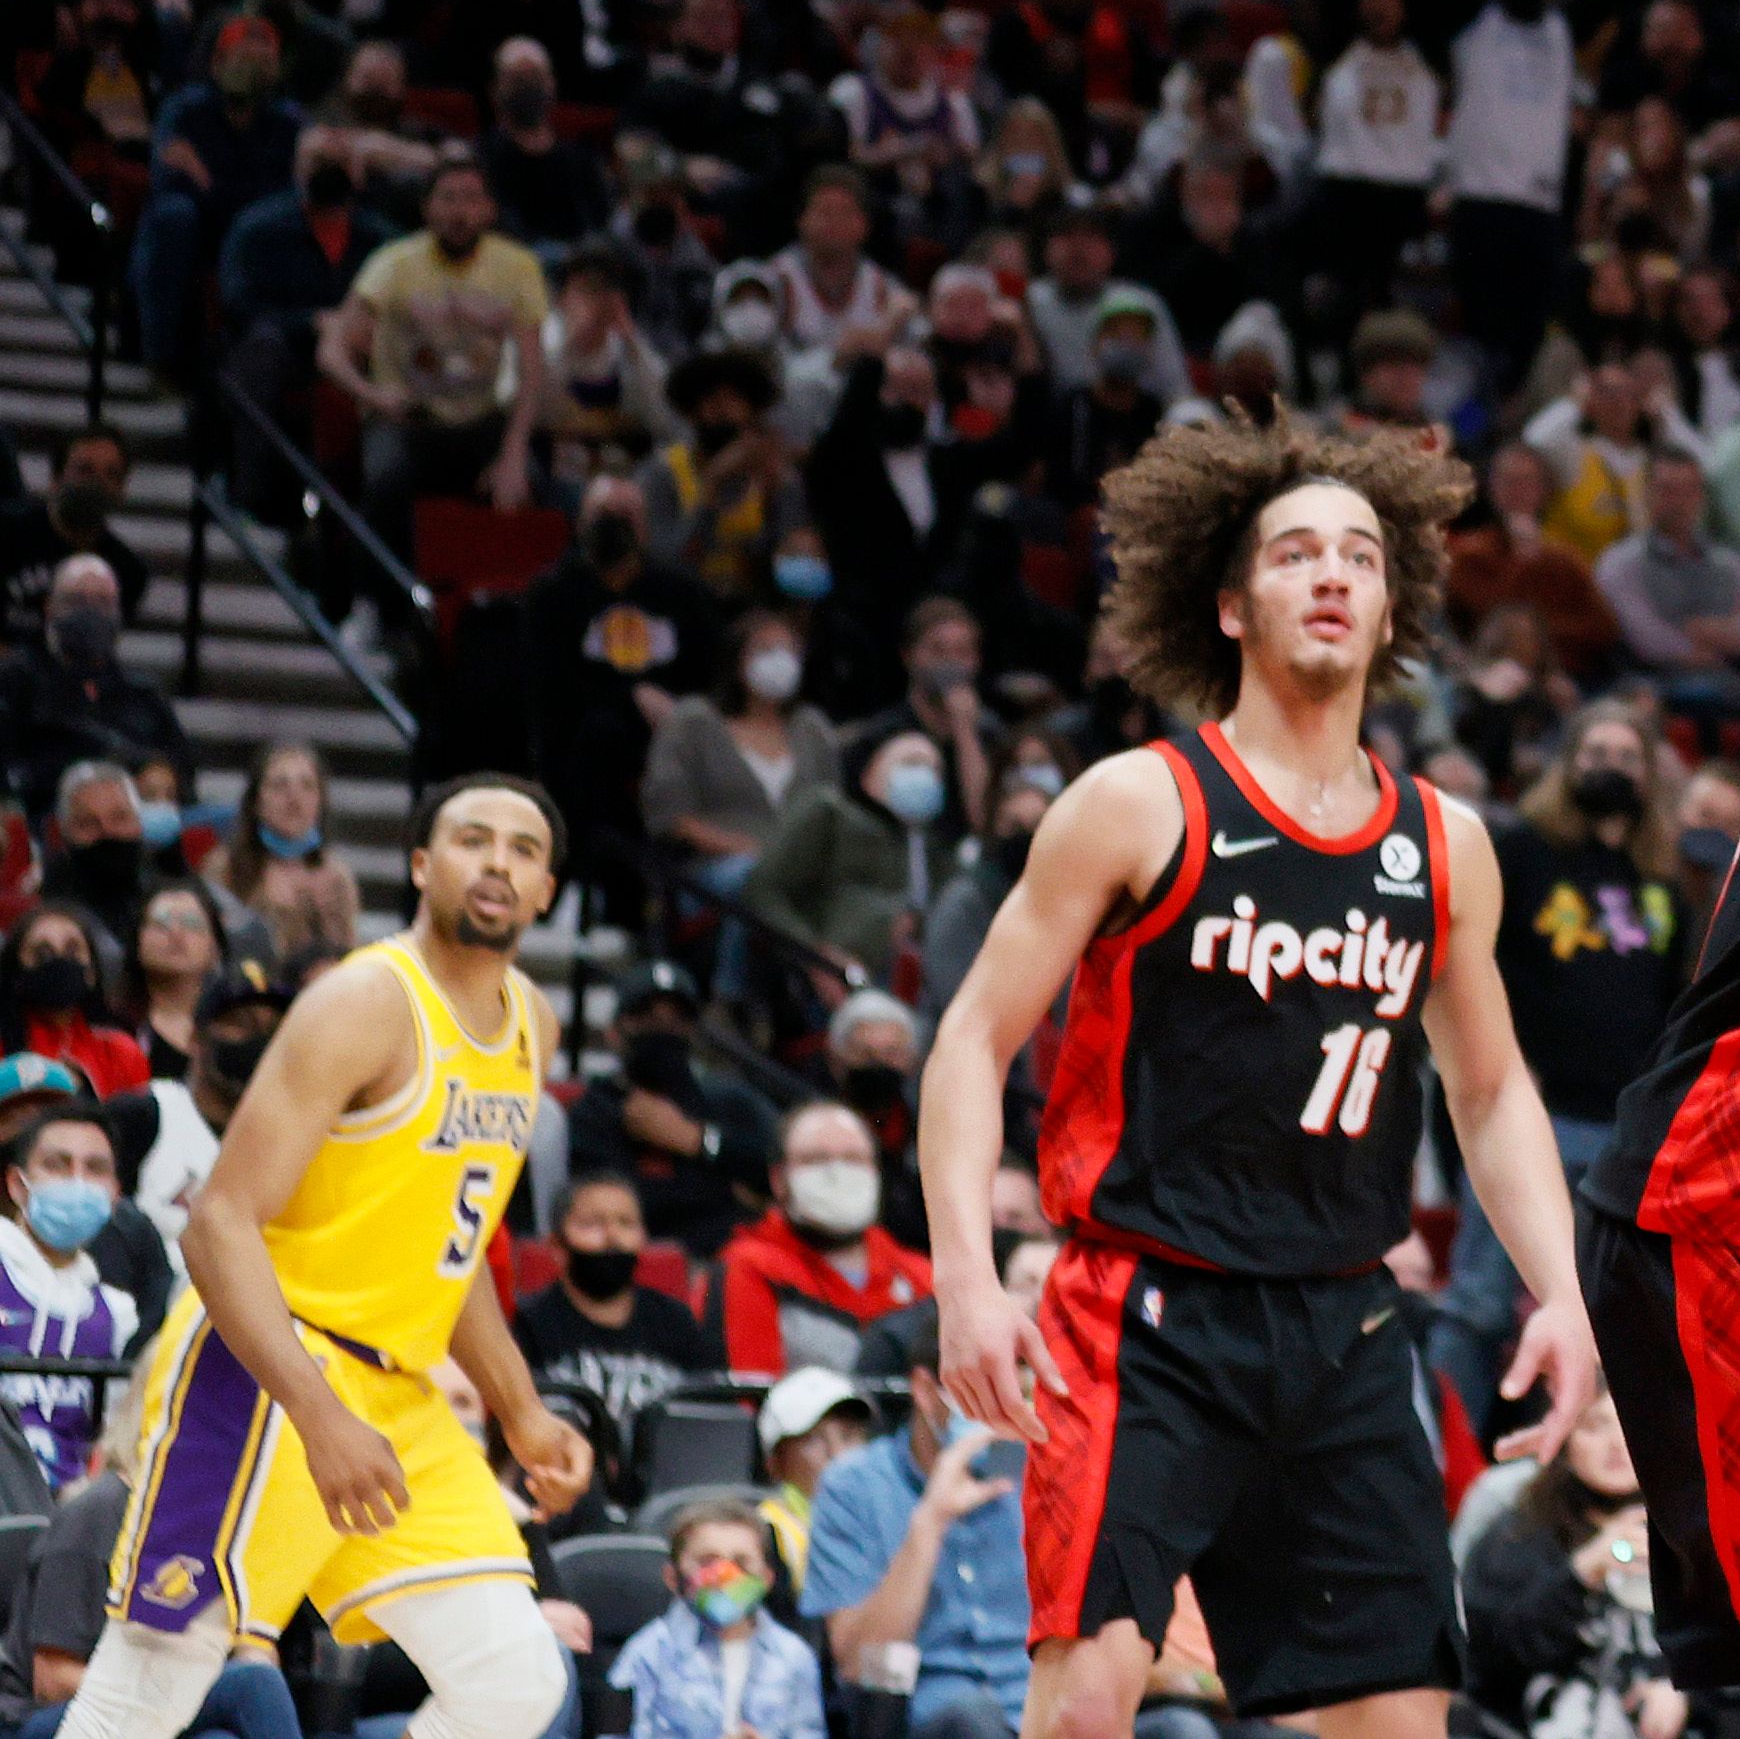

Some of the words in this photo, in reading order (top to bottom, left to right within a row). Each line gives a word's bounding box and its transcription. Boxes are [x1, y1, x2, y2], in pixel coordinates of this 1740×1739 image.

[1191, 893, 1425, 1019] ripcity
[1300, 1022, 1392, 1139] 16
[437, 1165, 495, 1278] 5
